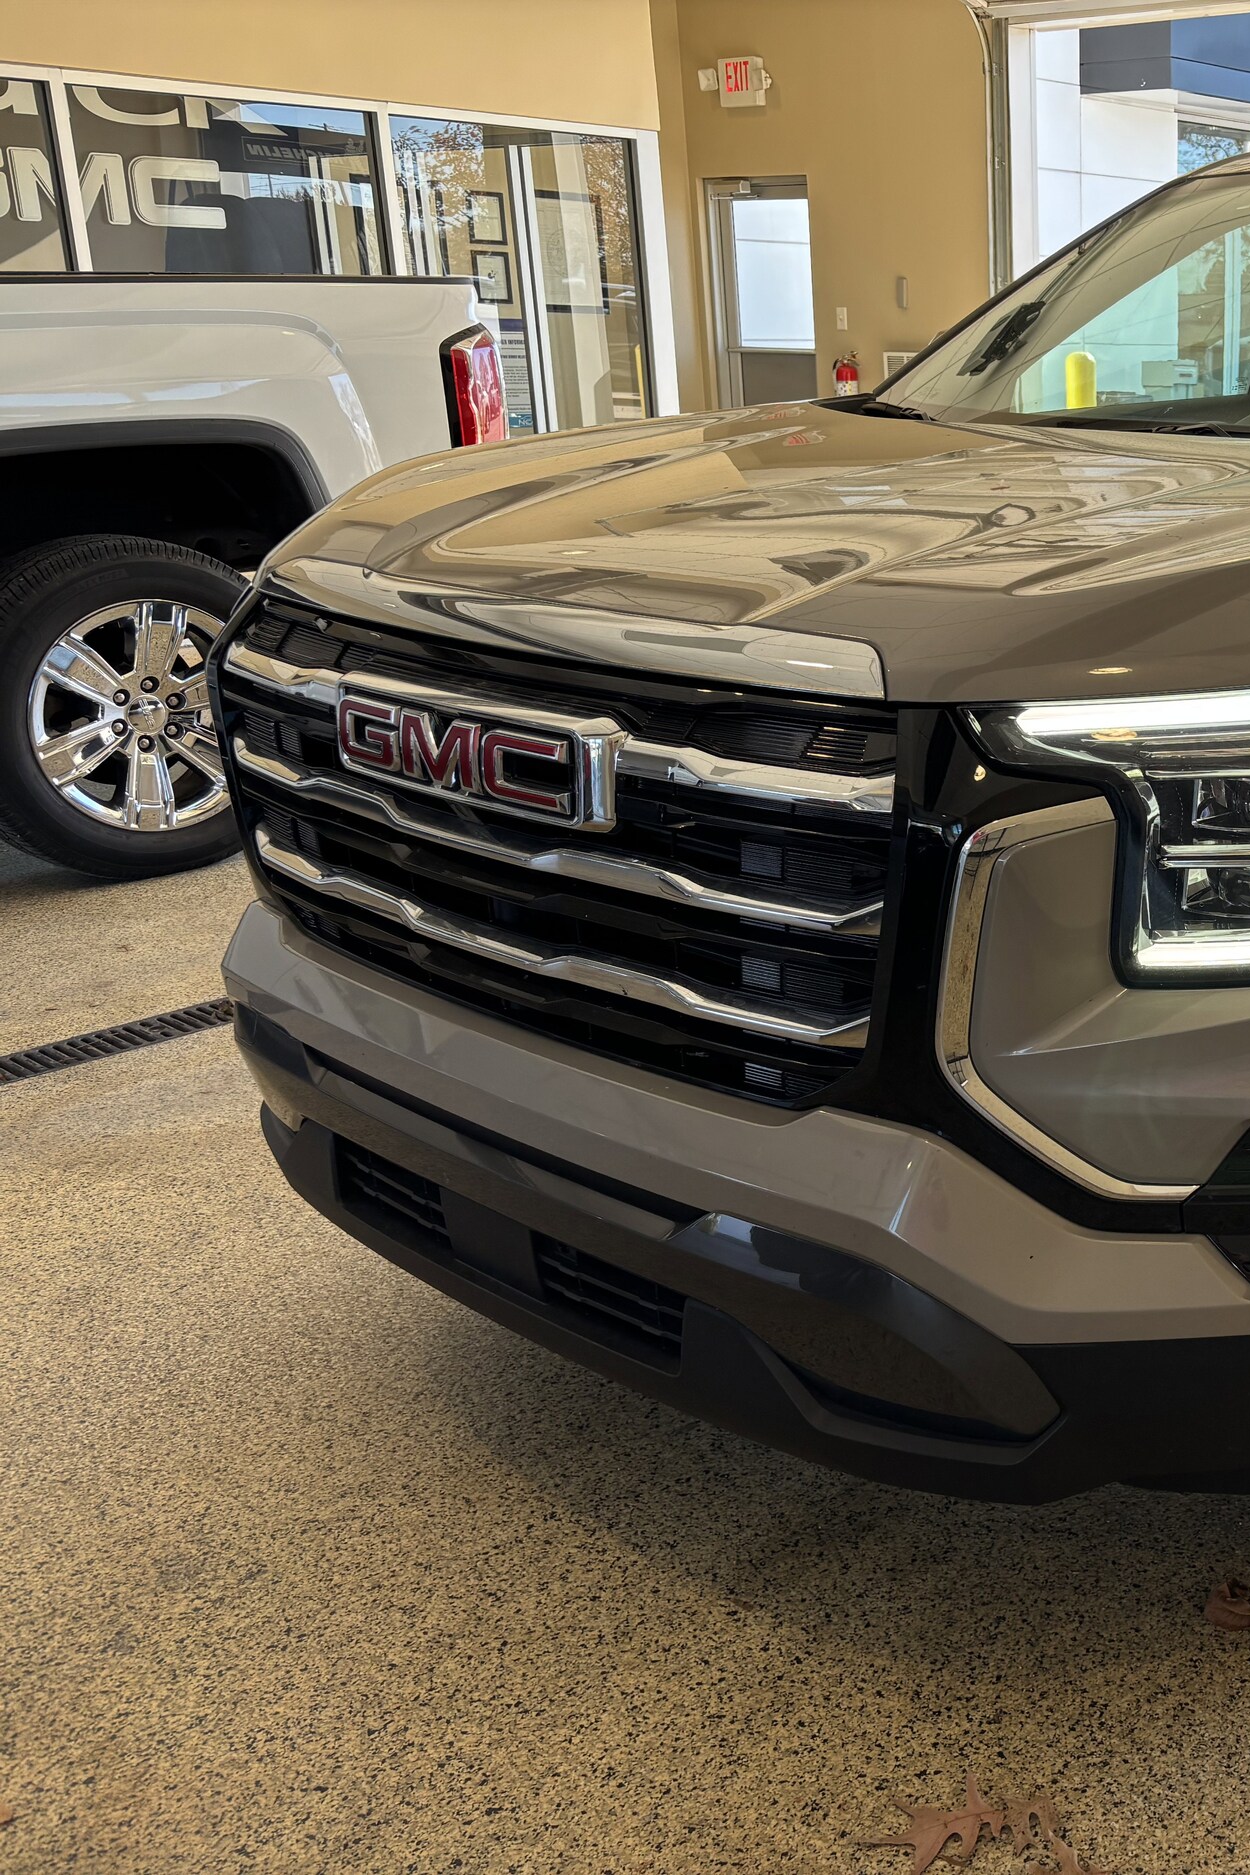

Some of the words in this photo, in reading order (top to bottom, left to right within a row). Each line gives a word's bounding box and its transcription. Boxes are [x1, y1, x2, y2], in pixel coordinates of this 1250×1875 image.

[725, 61, 749, 92] EXIT
[0, 145, 227, 229] MC
[337, 695, 571, 815] GMC
